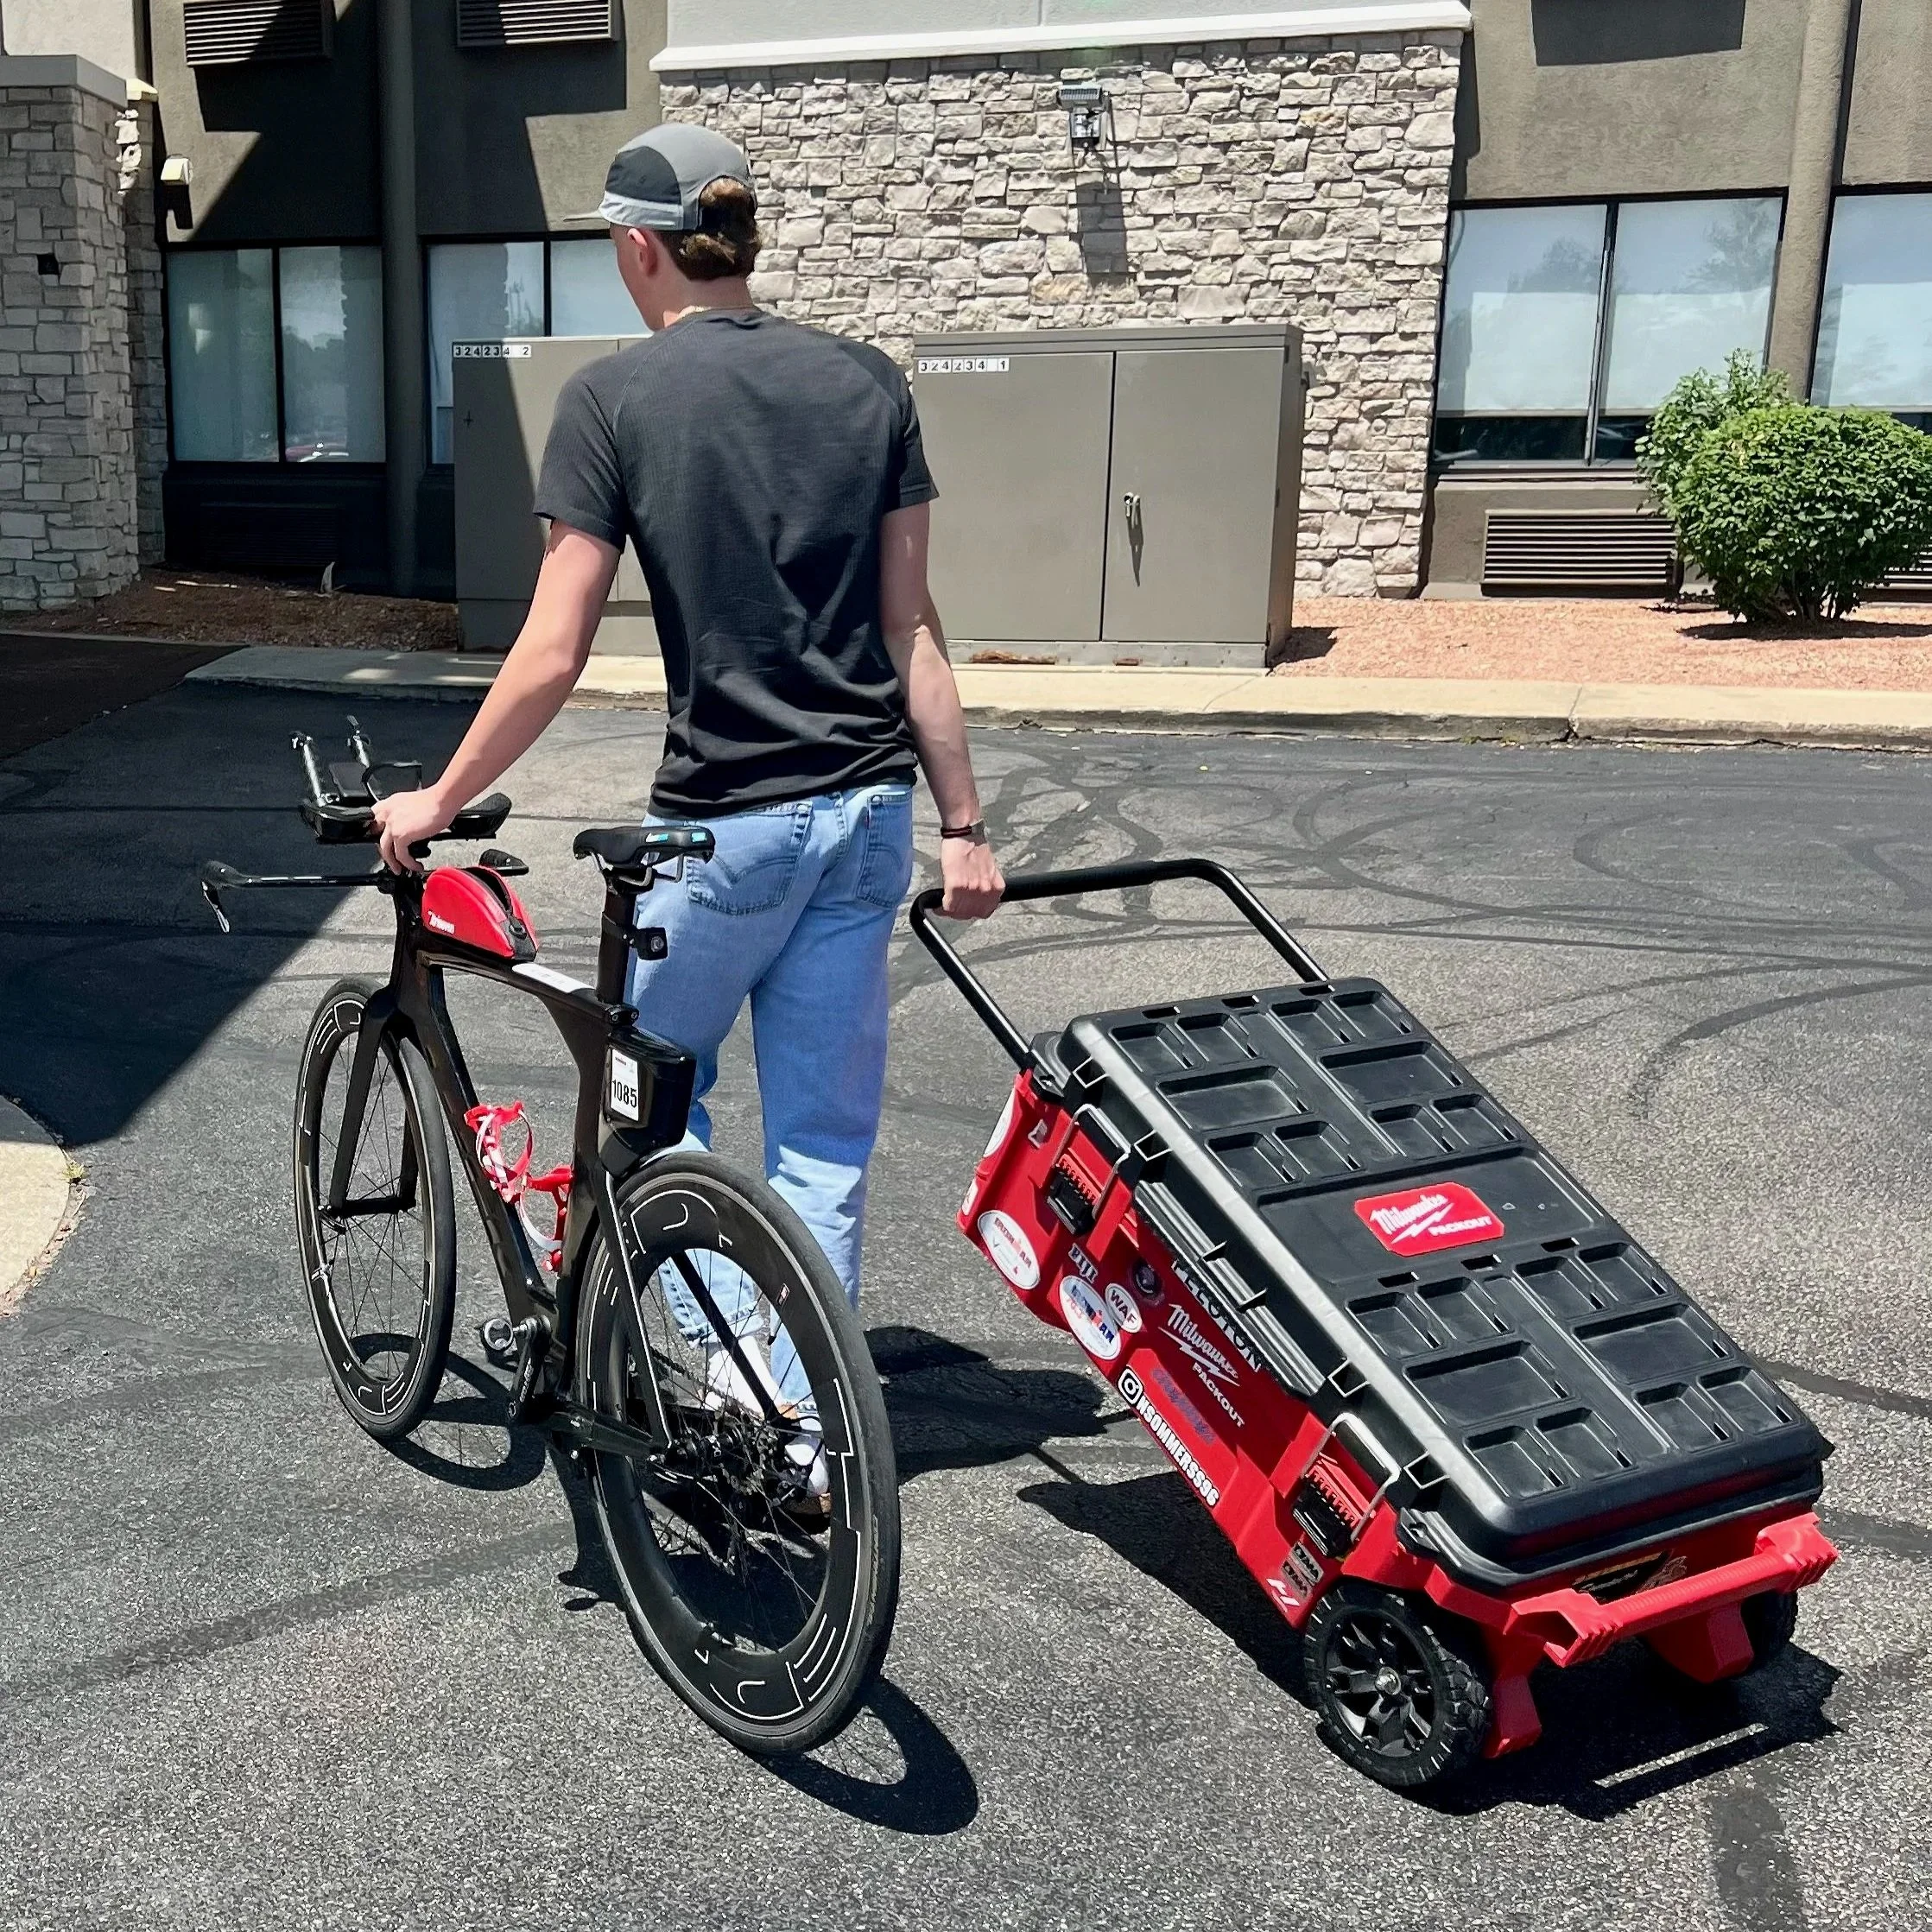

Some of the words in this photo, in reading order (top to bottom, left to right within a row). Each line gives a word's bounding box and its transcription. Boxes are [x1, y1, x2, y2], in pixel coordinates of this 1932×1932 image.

[455, 346, 510, 356] 324234
[522, 346, 529, 356] 2
[920, 360, 985, 372] 324234
[999, 360, 1006, 370] 1
[611, 1079, 637, 1108] 1085
[1110, 1289, 1137, 1324] WAF
[1192, 1362, 1245, 1428] PACKOUT
